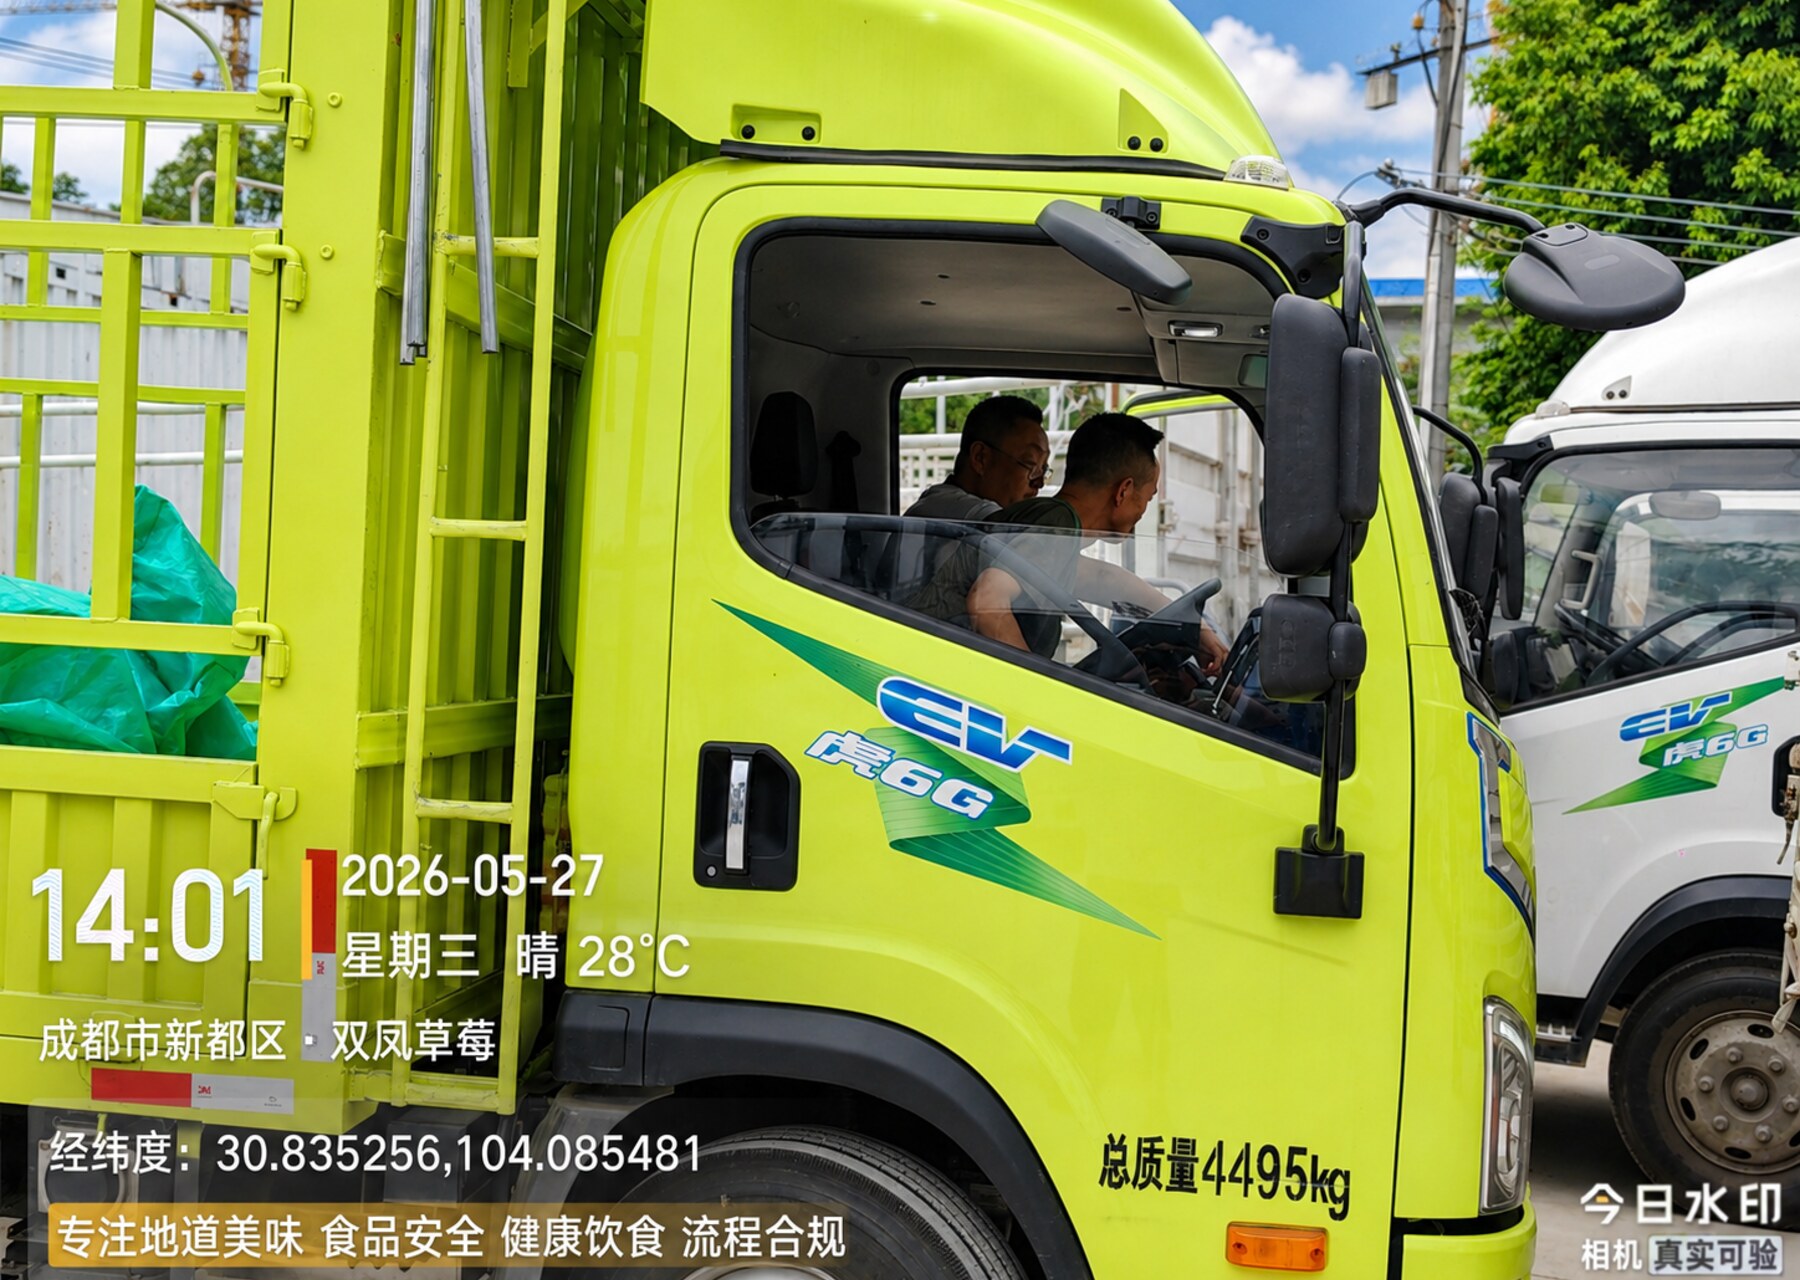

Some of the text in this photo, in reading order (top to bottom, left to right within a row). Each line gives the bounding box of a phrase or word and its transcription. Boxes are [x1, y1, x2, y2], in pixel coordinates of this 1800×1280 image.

[877, 676, 1073, 773] EV
[1619, 691, 1732, 742] EV
[1662, 724, 1769, 768] 虎6G
[804, 730, 995, 820] 虎6G
[1098, 1133, 1351, 1222] 总质量4495kg
